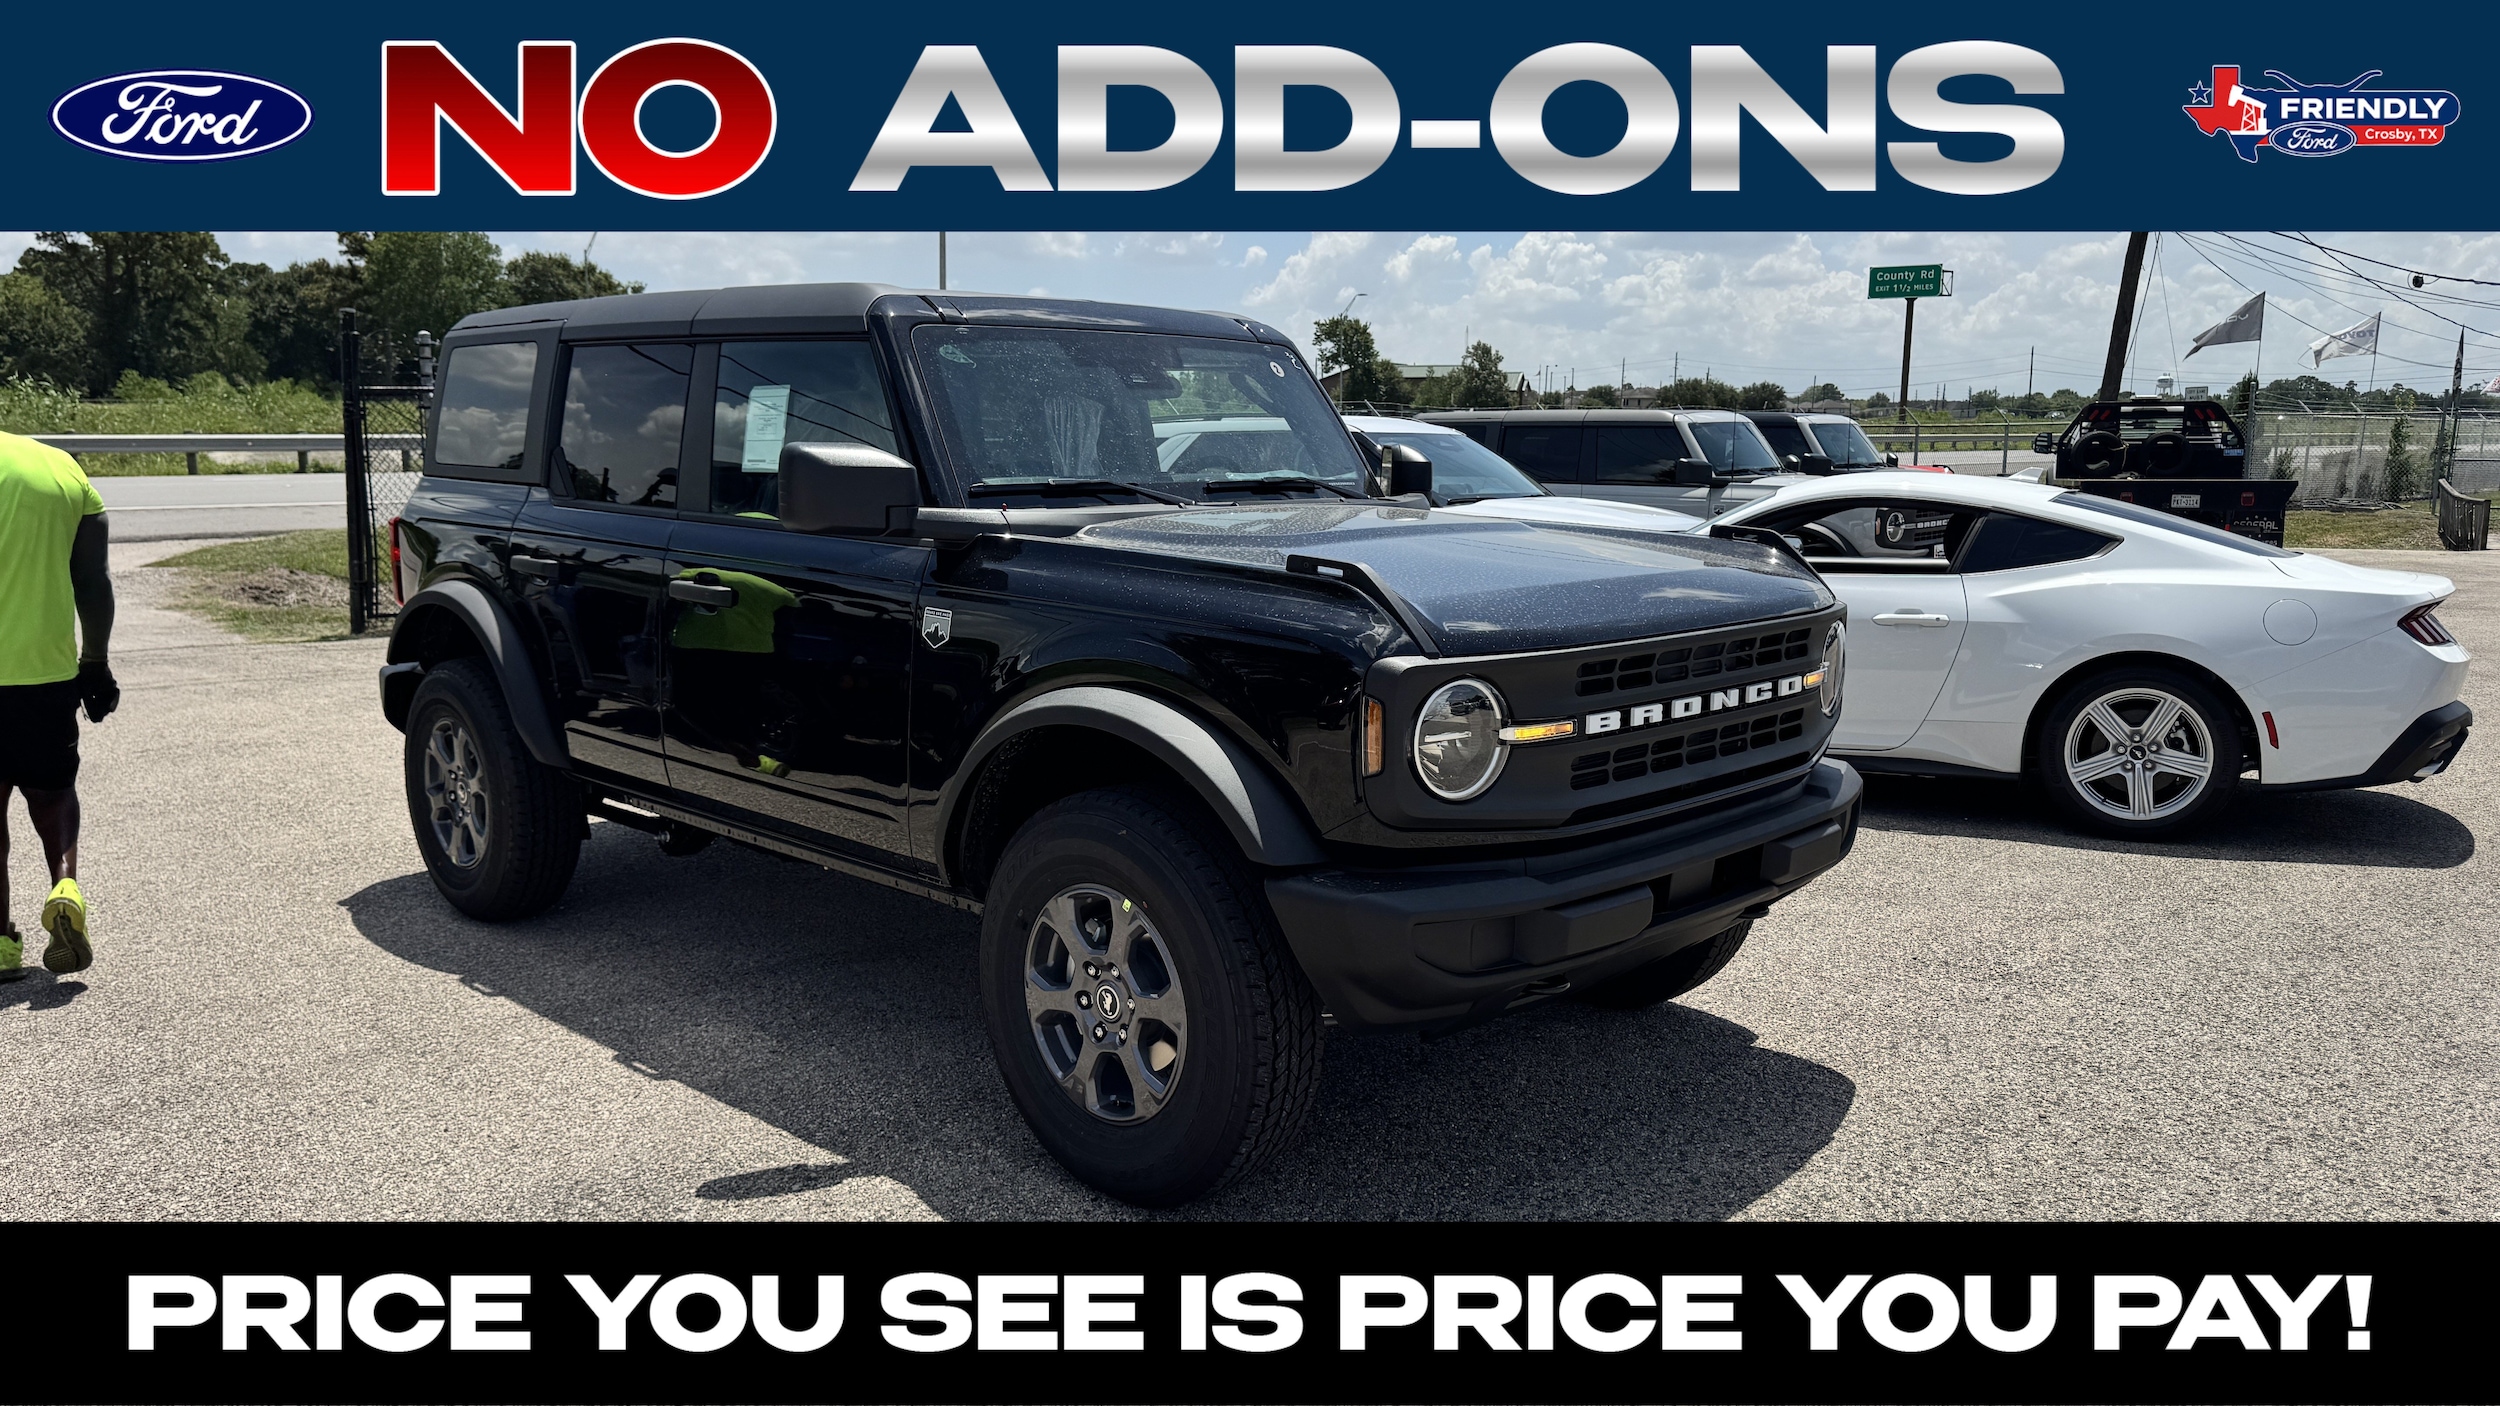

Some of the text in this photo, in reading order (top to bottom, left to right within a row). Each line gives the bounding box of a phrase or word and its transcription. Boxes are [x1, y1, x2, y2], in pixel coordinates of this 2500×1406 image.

[1876, 269, 1935, 282] County Rd
[1913, 283, 1934, 291] MILES
[1585, 674, 1803, 735] BRONCO
